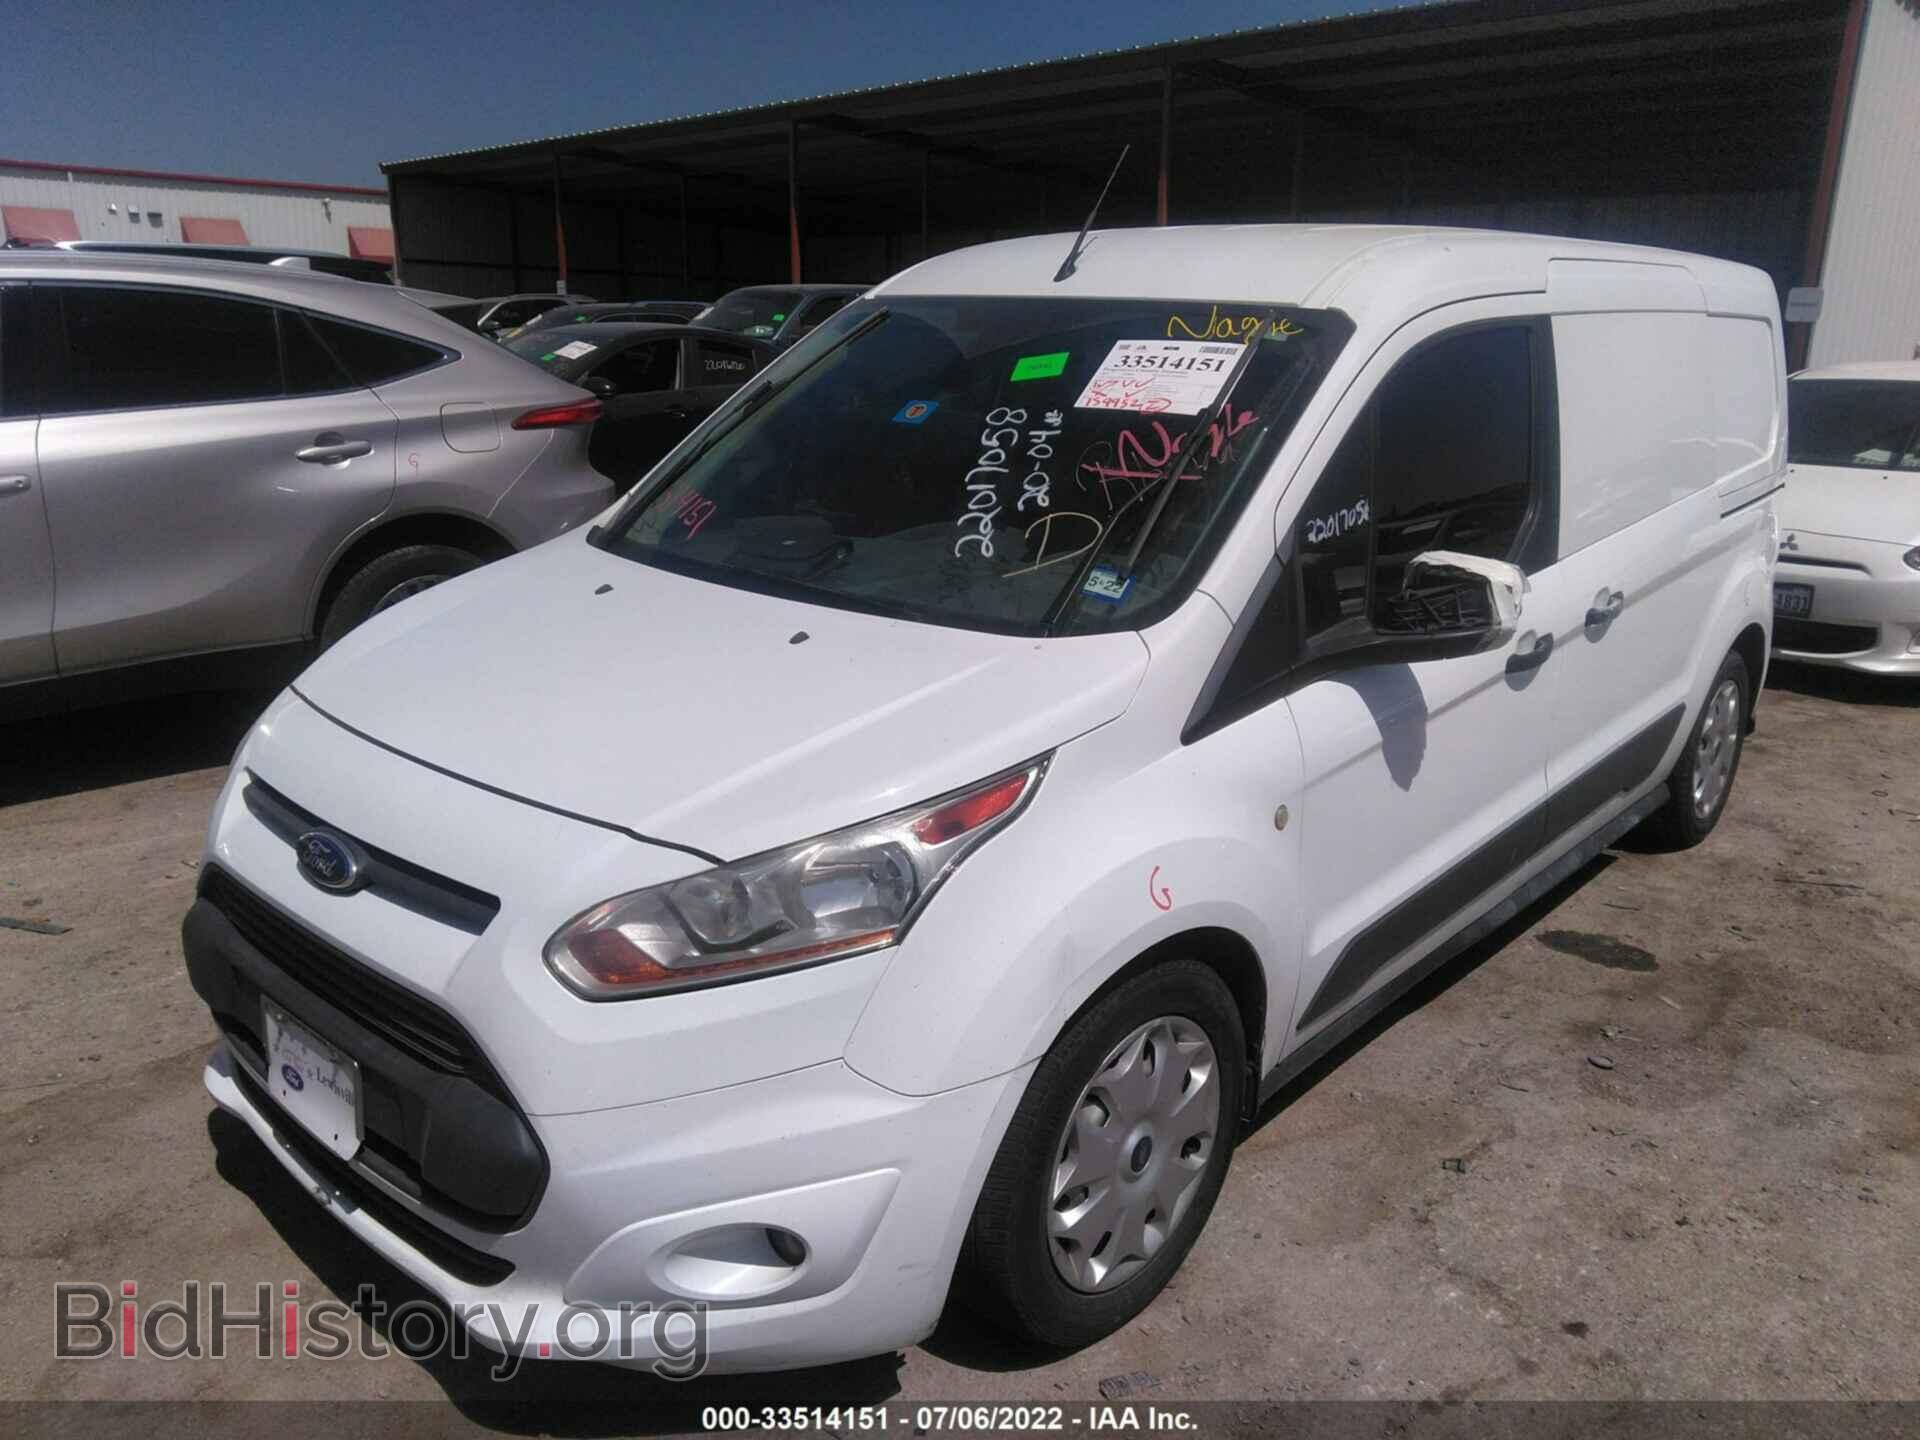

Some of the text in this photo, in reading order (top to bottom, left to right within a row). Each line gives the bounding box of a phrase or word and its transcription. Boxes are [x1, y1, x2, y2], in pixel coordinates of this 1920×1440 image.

[1113, 354, 1227, 373] 33514151
[955, 407, 1028, 559] 22017058
[308, 839, 337, 877] Ford
